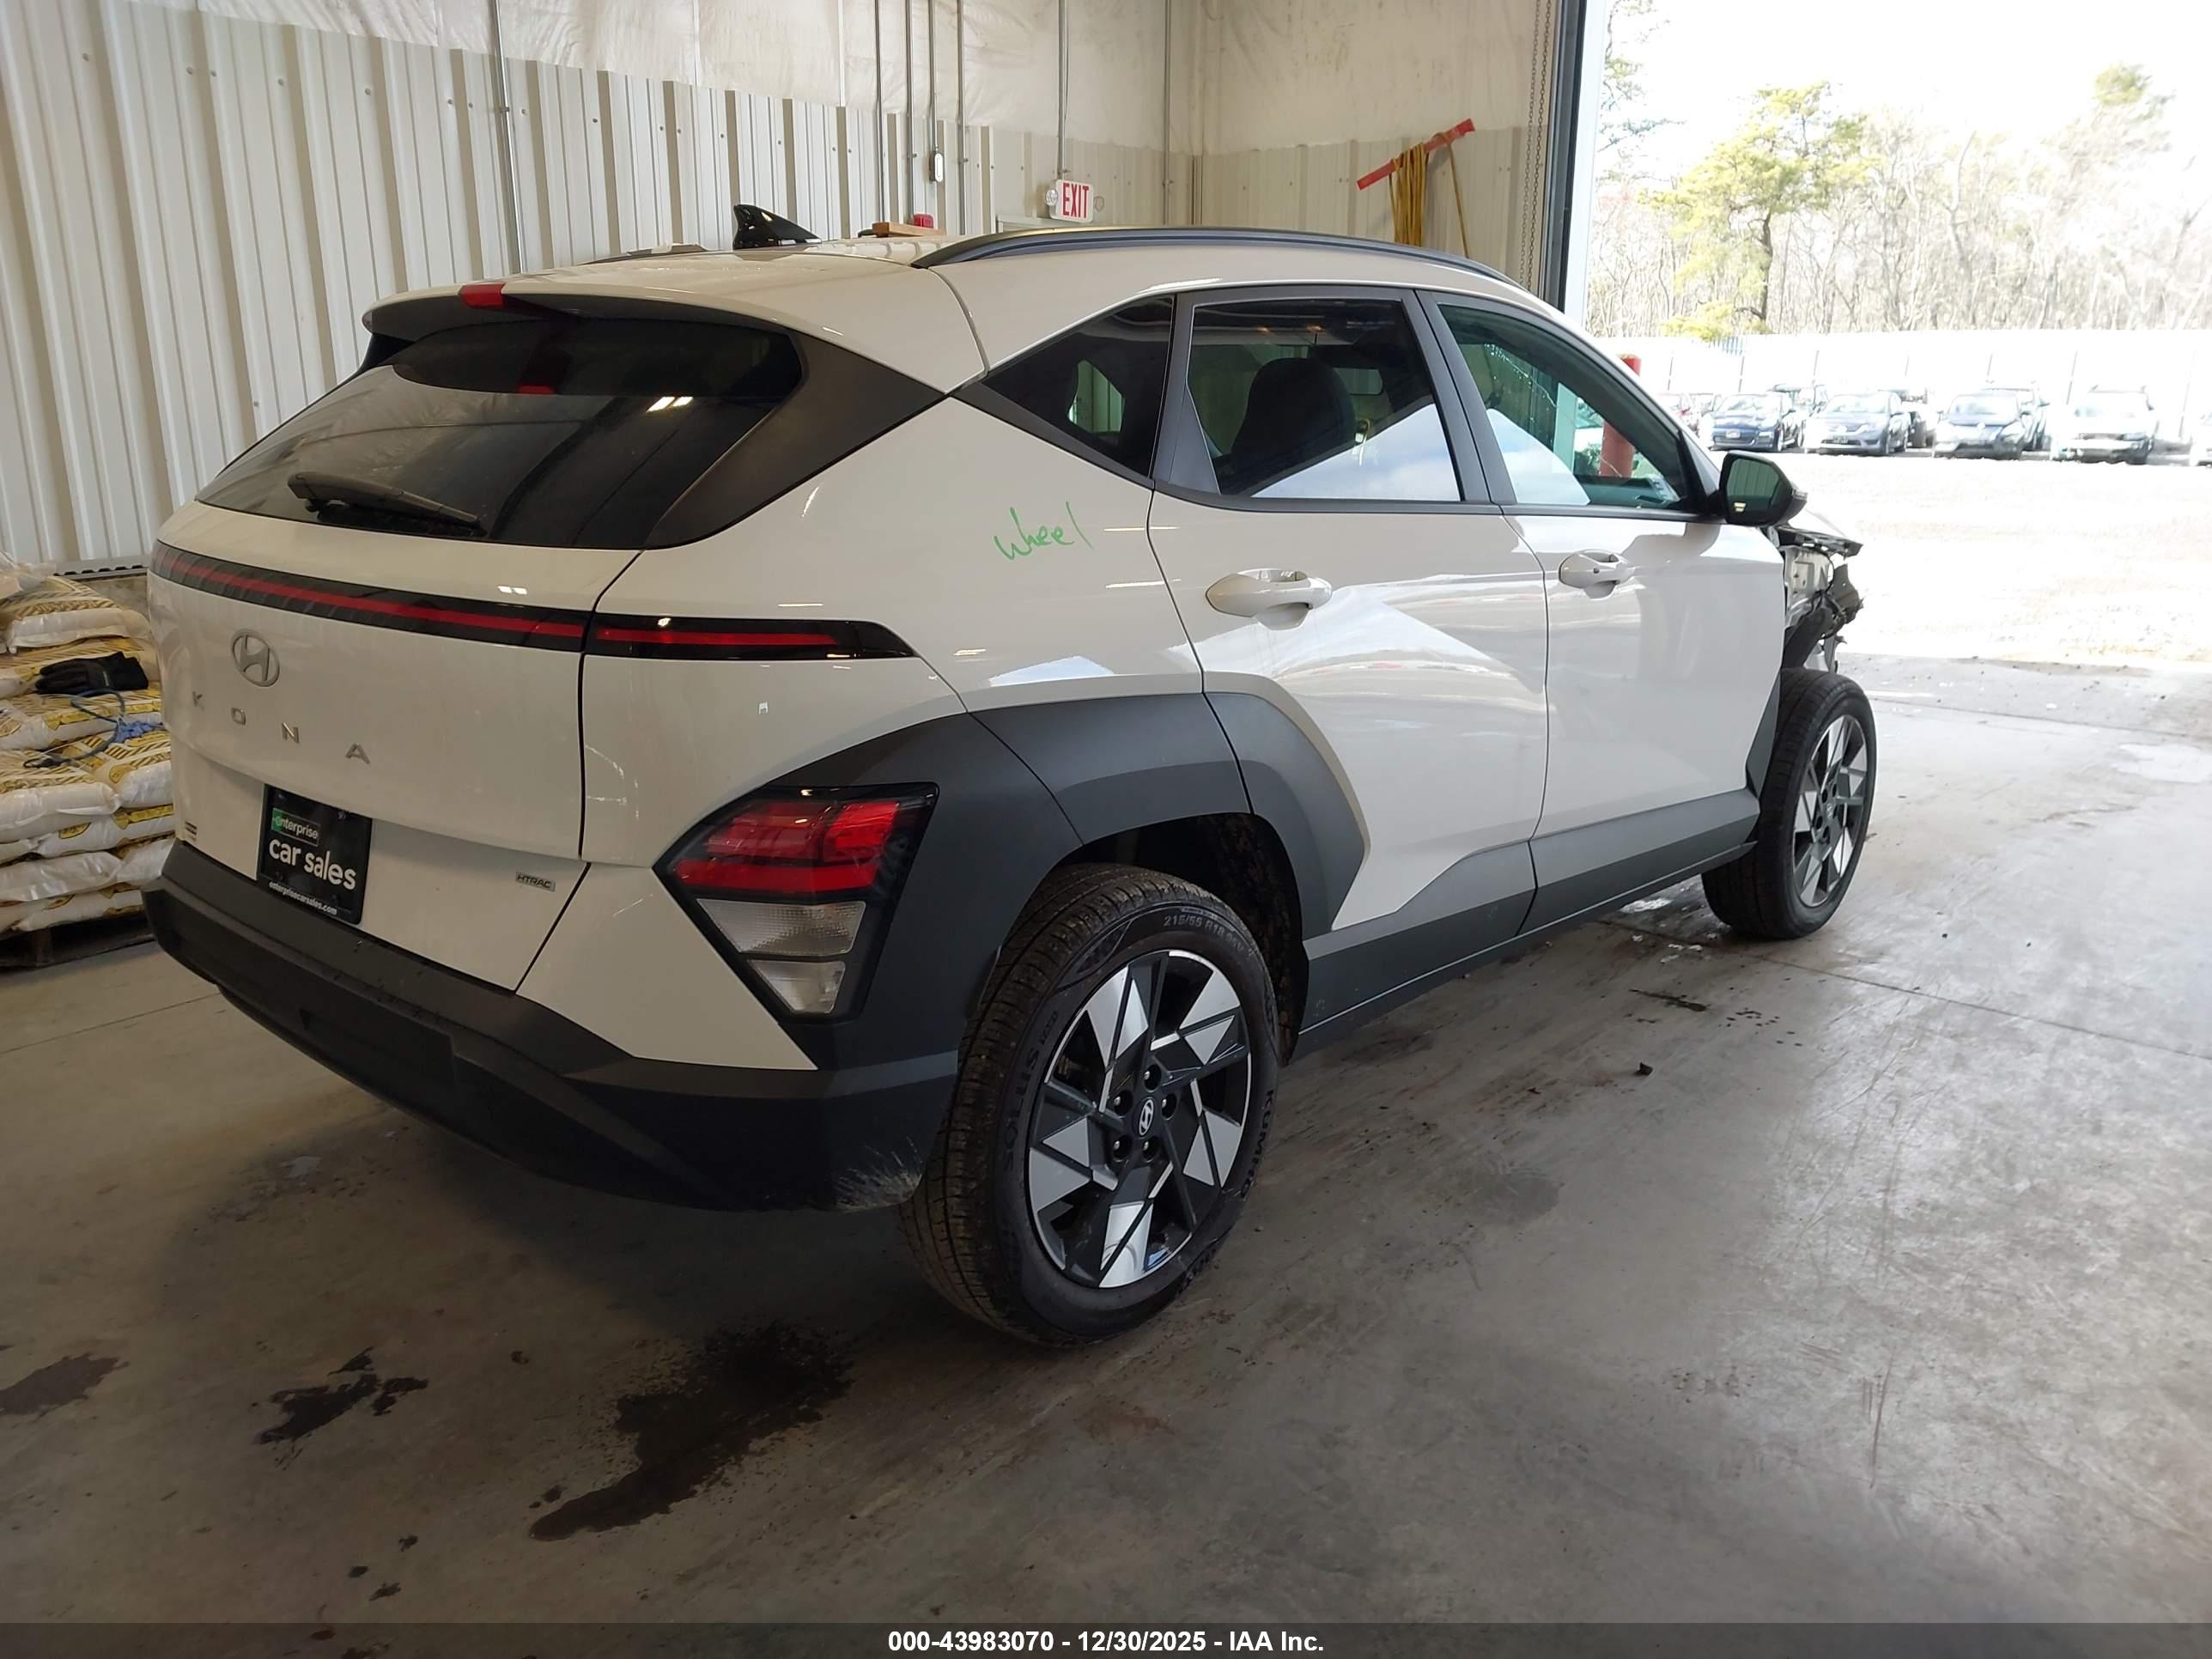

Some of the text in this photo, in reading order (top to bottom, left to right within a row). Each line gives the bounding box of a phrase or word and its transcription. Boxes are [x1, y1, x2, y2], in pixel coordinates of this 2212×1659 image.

[1062, 182, 1090, 218] EXIT
[994, 501, 1095, 559] wheel
[192, 691, 371, 764] KONA
[274, 815, 319, 840] enterprise
[269, 839, 356, 890] car sales
[517, 873, 551, 890] HTRAC
[269, 881, 337, 915] enterprisecarsales.com
